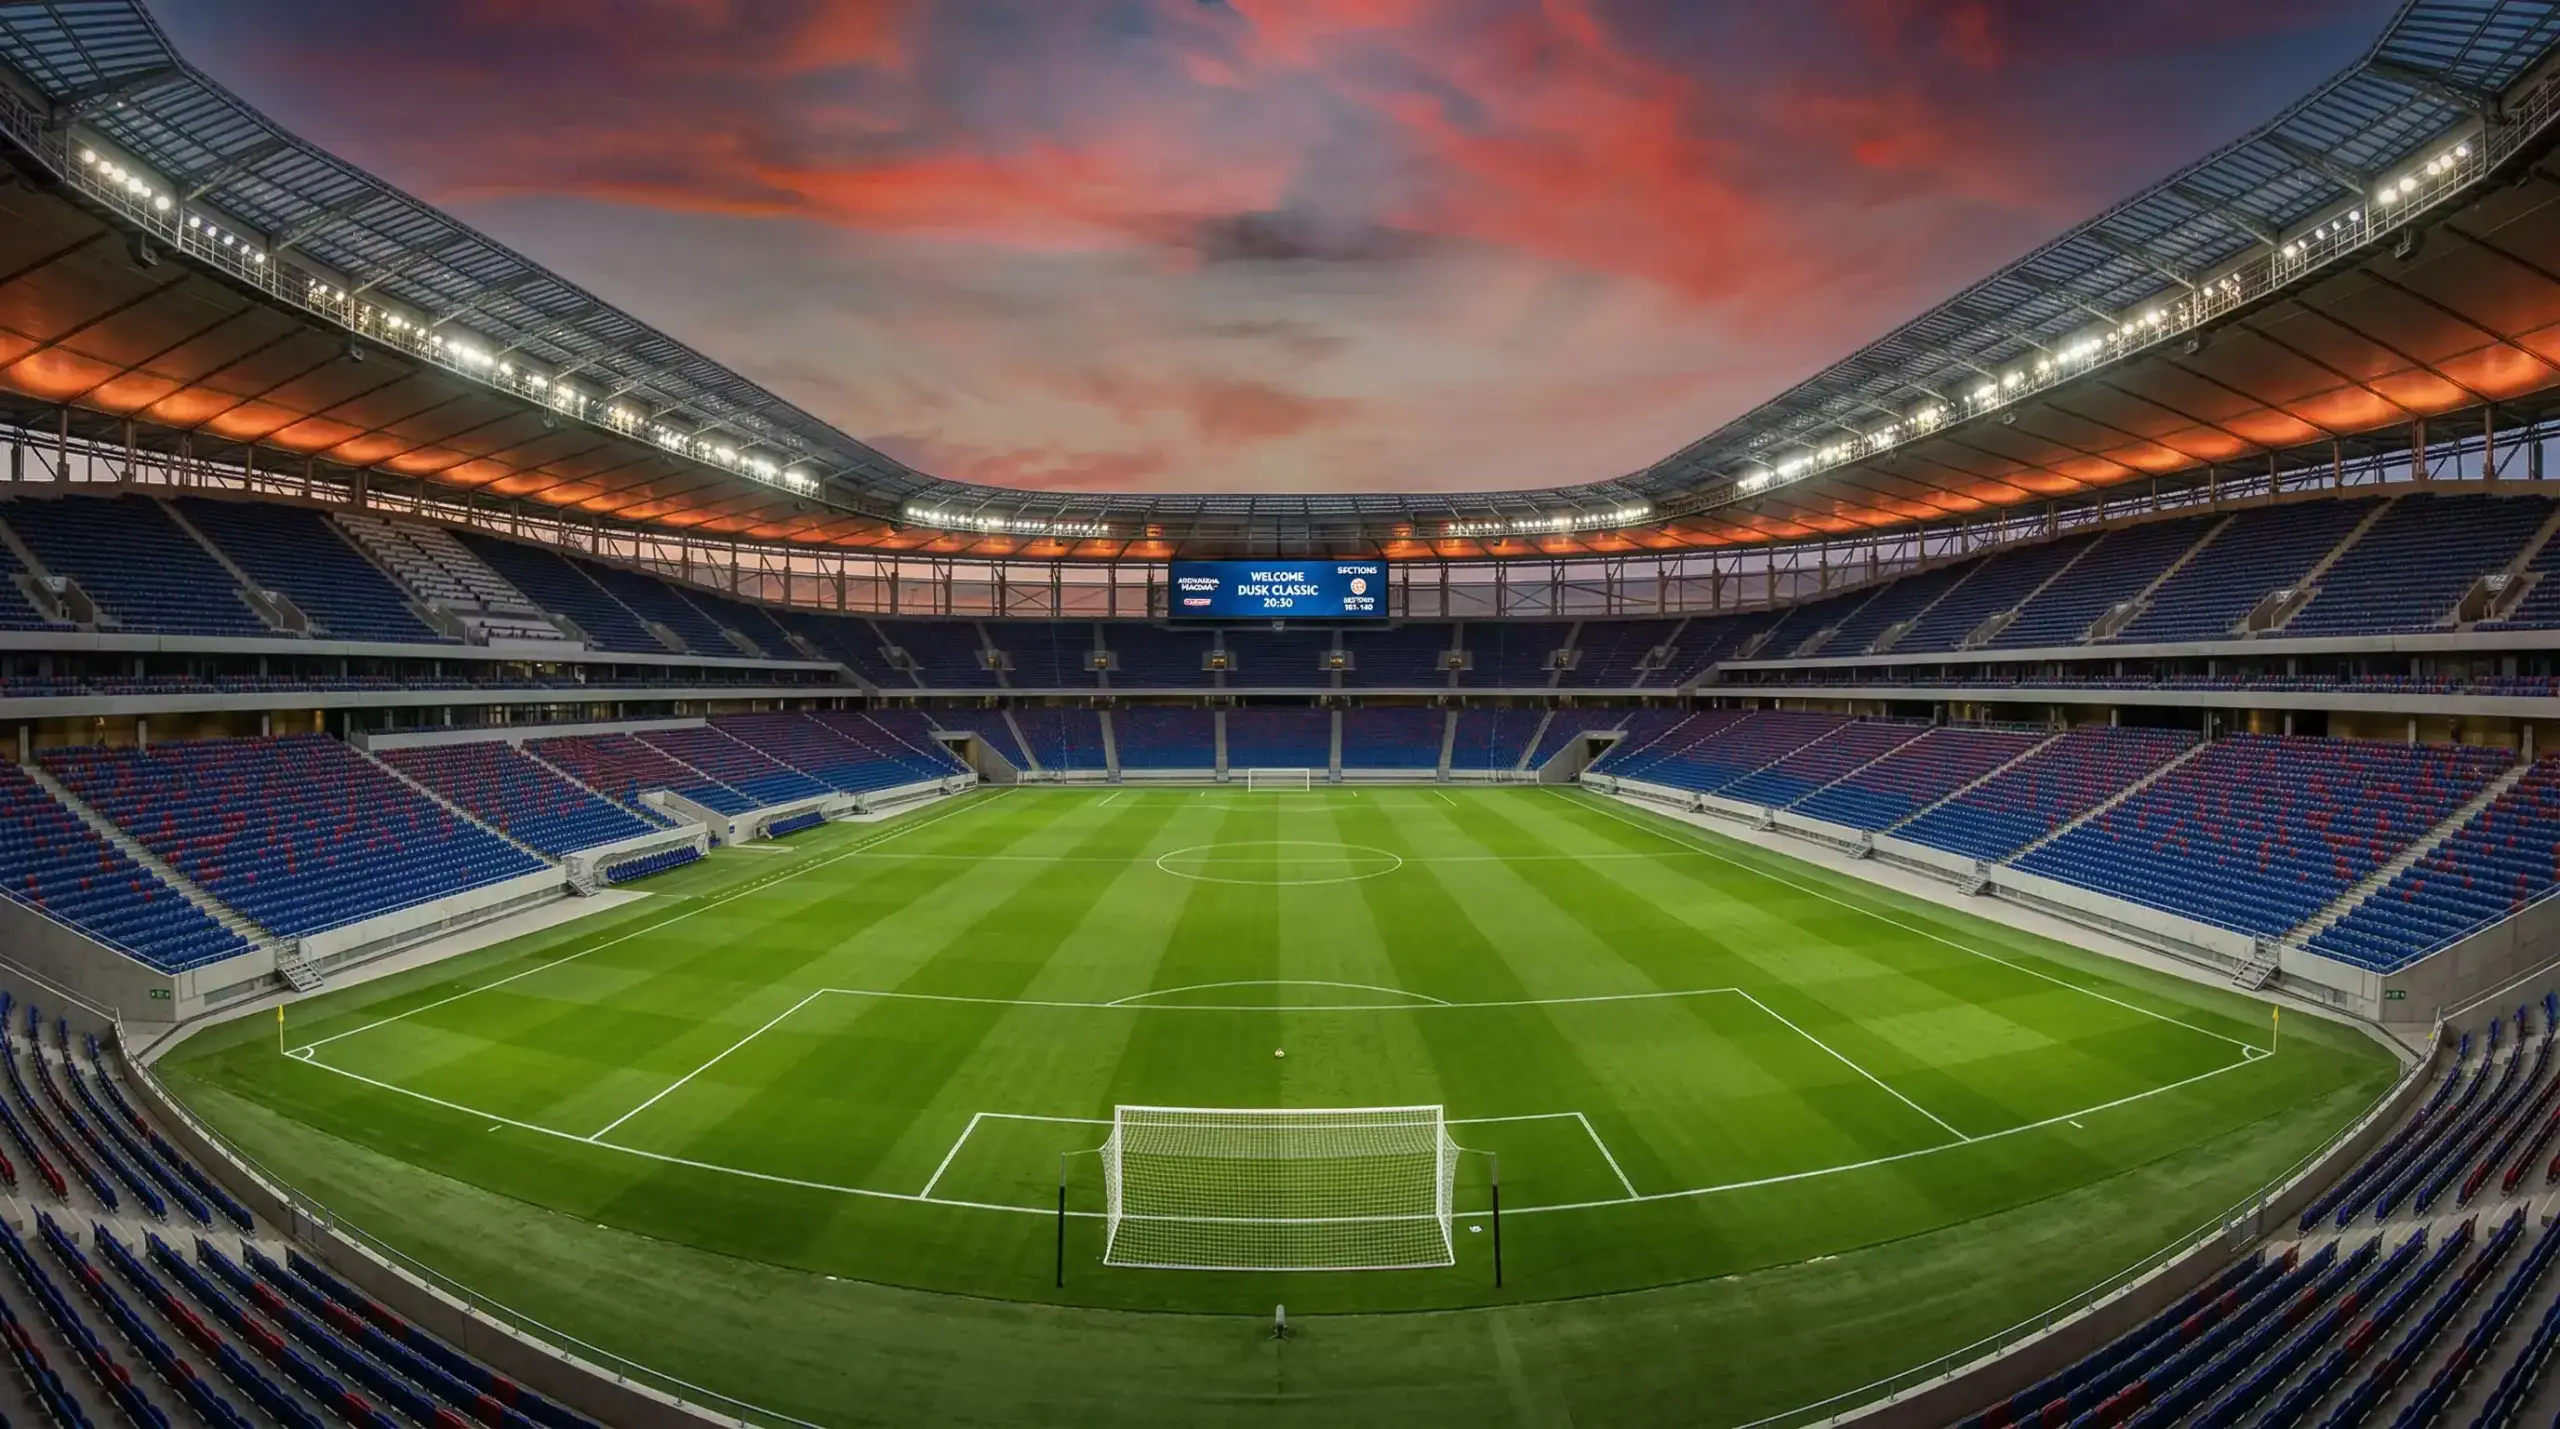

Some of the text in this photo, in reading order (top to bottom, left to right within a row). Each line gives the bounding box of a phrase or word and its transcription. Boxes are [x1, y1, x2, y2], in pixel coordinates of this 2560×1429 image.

[1251, 572, 1305, 582] WELCOME
[1238, 585, 1319, 596] DUSK CLASSIC
[1263, 598, 1293, 608] 20:30
